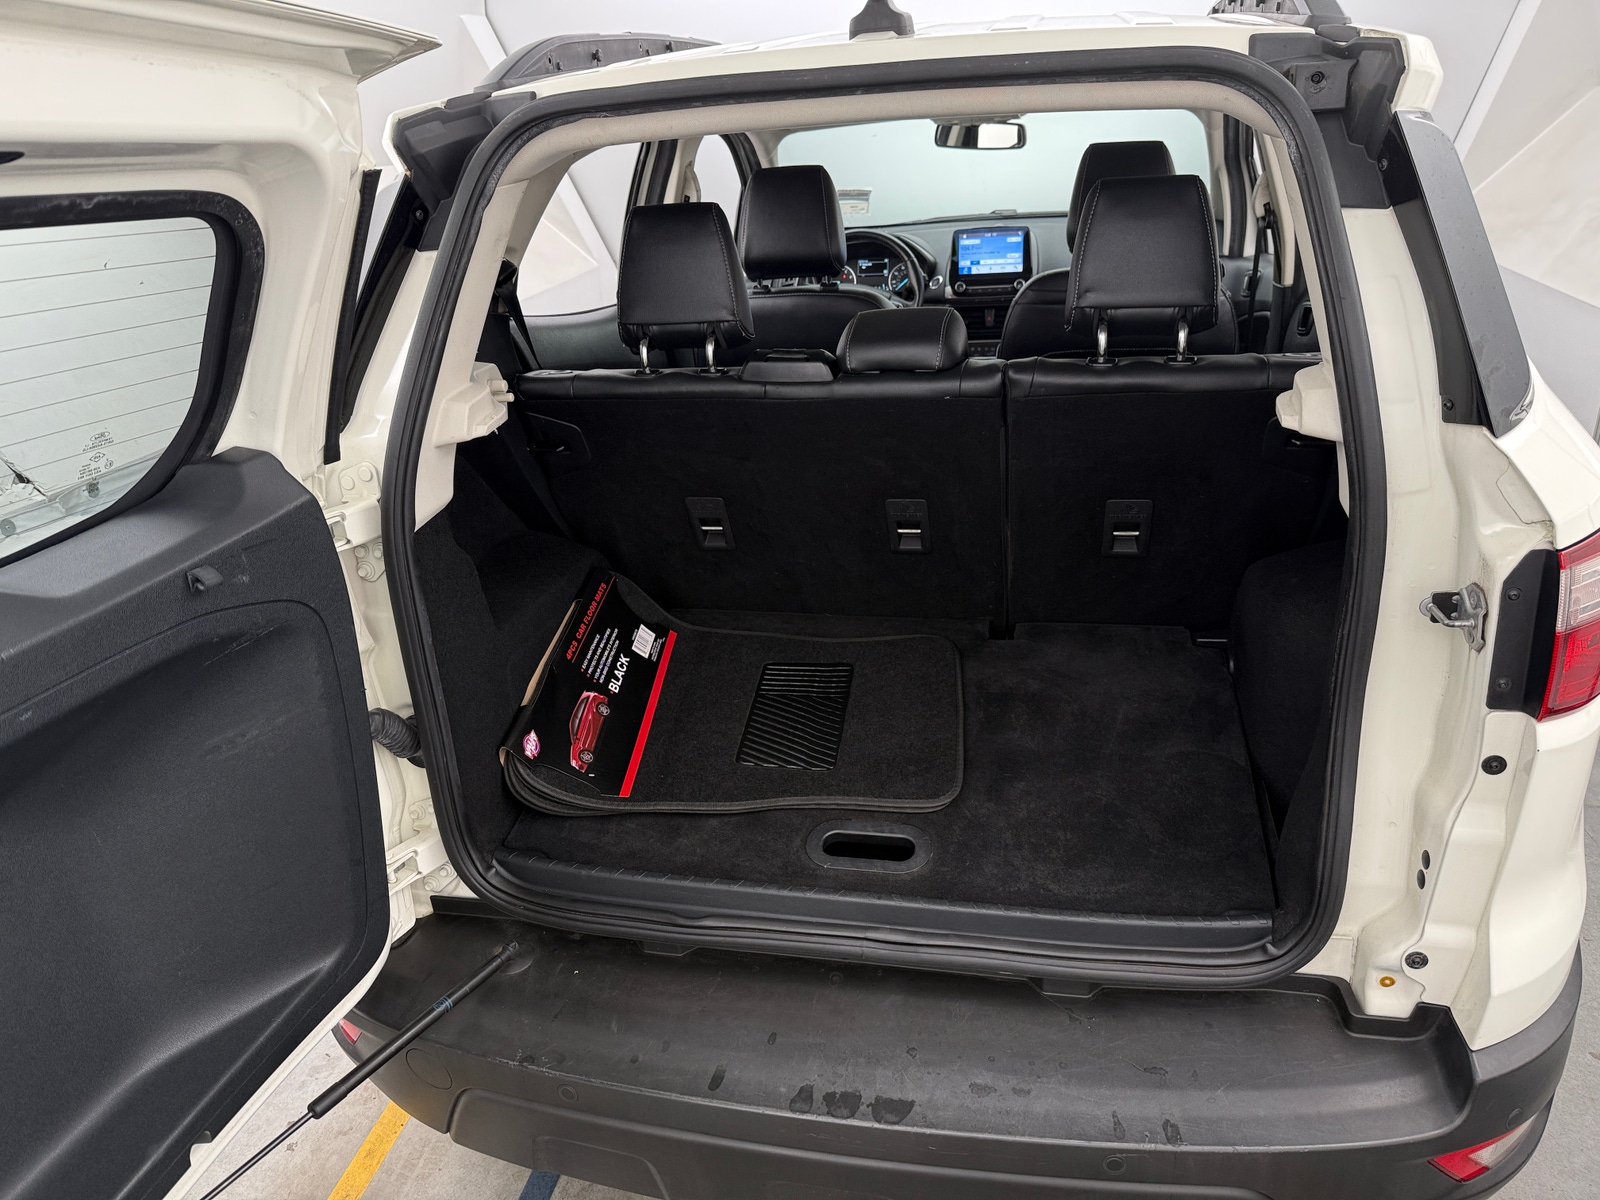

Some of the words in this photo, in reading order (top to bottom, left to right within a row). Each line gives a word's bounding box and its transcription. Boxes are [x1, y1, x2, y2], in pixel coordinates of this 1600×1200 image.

[566, 640, 578, 660] 4PCS
[576, 623, 586, 639] CAR
[583, 601, 597, 624] FLOOR
[594, 582, 607, 602] MATS
[608, 653, 630, 693] BLACK
